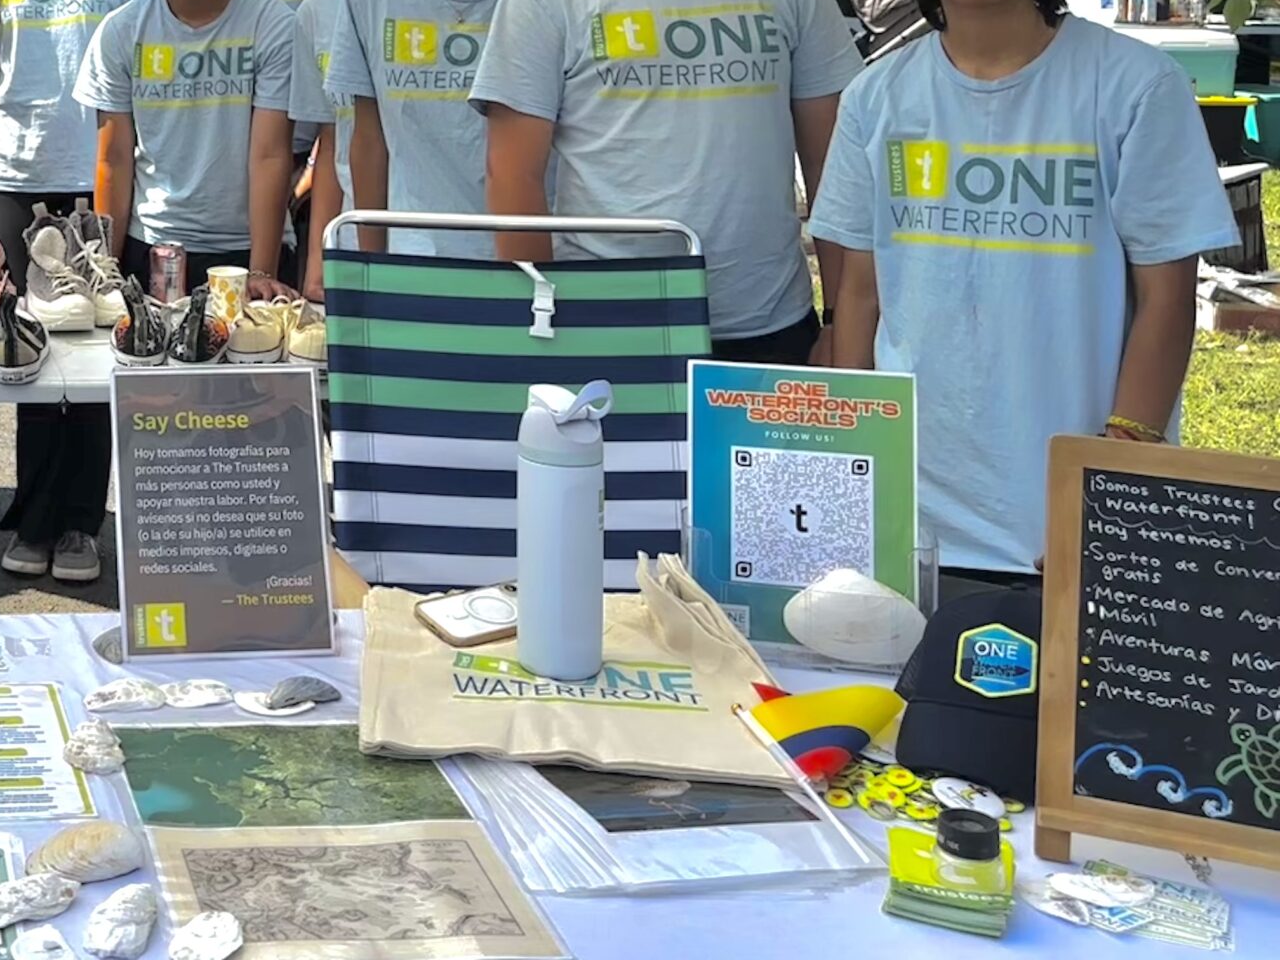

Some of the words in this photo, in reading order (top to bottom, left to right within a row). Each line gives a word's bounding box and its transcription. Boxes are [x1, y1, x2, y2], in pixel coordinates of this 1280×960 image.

[405, 27, 425, 59] t
[616, 17, 645, 52] t
[664, 15, 781, 60] ONE
[178, 45, 255, 79] ONE
[596, 58, 780, 86] WATERFRONT
[133, 78, 253, 99] WATERFRONT
[891, 144, 902, 192] trustees
[955, 157, 1097, 207] ONE
[891, 205, 1093, 239] WATERFRONT
[776, 381, 828, 398] ONE
[707, 390, 901, 417] WATERFRONT'S
[133, 413, 169, 434] Say
[175, 411, 250, 430] Cheese
[748, 408, 857, 429] SOCIALS
[765, 430, 811, 441] FOLLOW
[815, 432, 835, 442] US!
[134, 448, 155, 461] Hoy
[157, 448, 207, 459] tomamos
[209, 446, 264, 460] fotografías
[266, 447, 291, 459] para
[135, 464, 202, 477] promocionar
[212, 462, 233, 473] The
[234, 461, 280, 473] Trustees
[136, 479, 158, 491] más
[160, 481, 208, 493] personas
[210, 481, 240, 490] como
[242, 478, 271, 489] usted
[1163, 485, 1256, 510] Trustees
[136, 496, 171, 510] apoyar
[174, 495, 215, 506] nuestra
[217, 493, 247, 505] labor.
[249, 493, 268, 505] Por
[269, 493, 299, 506] favor,
[196, 514, 209, 522] no
[212, 510, 244, 522] desea
[246, 513, 266, 525] que
[282, 510, 305, 521] foto
[790, 504, 808, 532] t
[163, 528, 177, 540] de
[193, 527, 228, 542] hijo/a)
[244, 527, 276, 538] utilice
[1087, 519, 1129, 541] Hoy
[1137, 528, 1247, 552] tenemos:
[138, 545, 178, 557] medios
[180, 544, 232, 557] impresos,
[234, 543, 279, 557] digitales
[1088, 542, 1161, 567] Sorteo
[1175, 559, 1199, 572] de
[139, 563, 169, 574] redes
[171, 562, 218, 573] sociales.
[1101, 564, 1163, 584] gratis
[266, 575, 313, 589] ¡Gracias!
[236, 593, 259, 606] The
[261, 592, 314, 605] Trustees
[1093, 586, 1191, 612] Mercado
[1200, 603, 1224, 619] de
[154, 608, 176, 641] t
[1100, 605, 1157, 627] Móvil
[975, 640, 1019, 661] ONE
[1098, 628, 1211, 661] Aventuras
[604, 667, 693, 692] NE
[1097, 656, 1172, 682] Juegos
[1183, 674, 1212, 689] de
[453, 673, 703, 706] WATERFRONT
[1096, 680, 1216, 716] Artesanías
